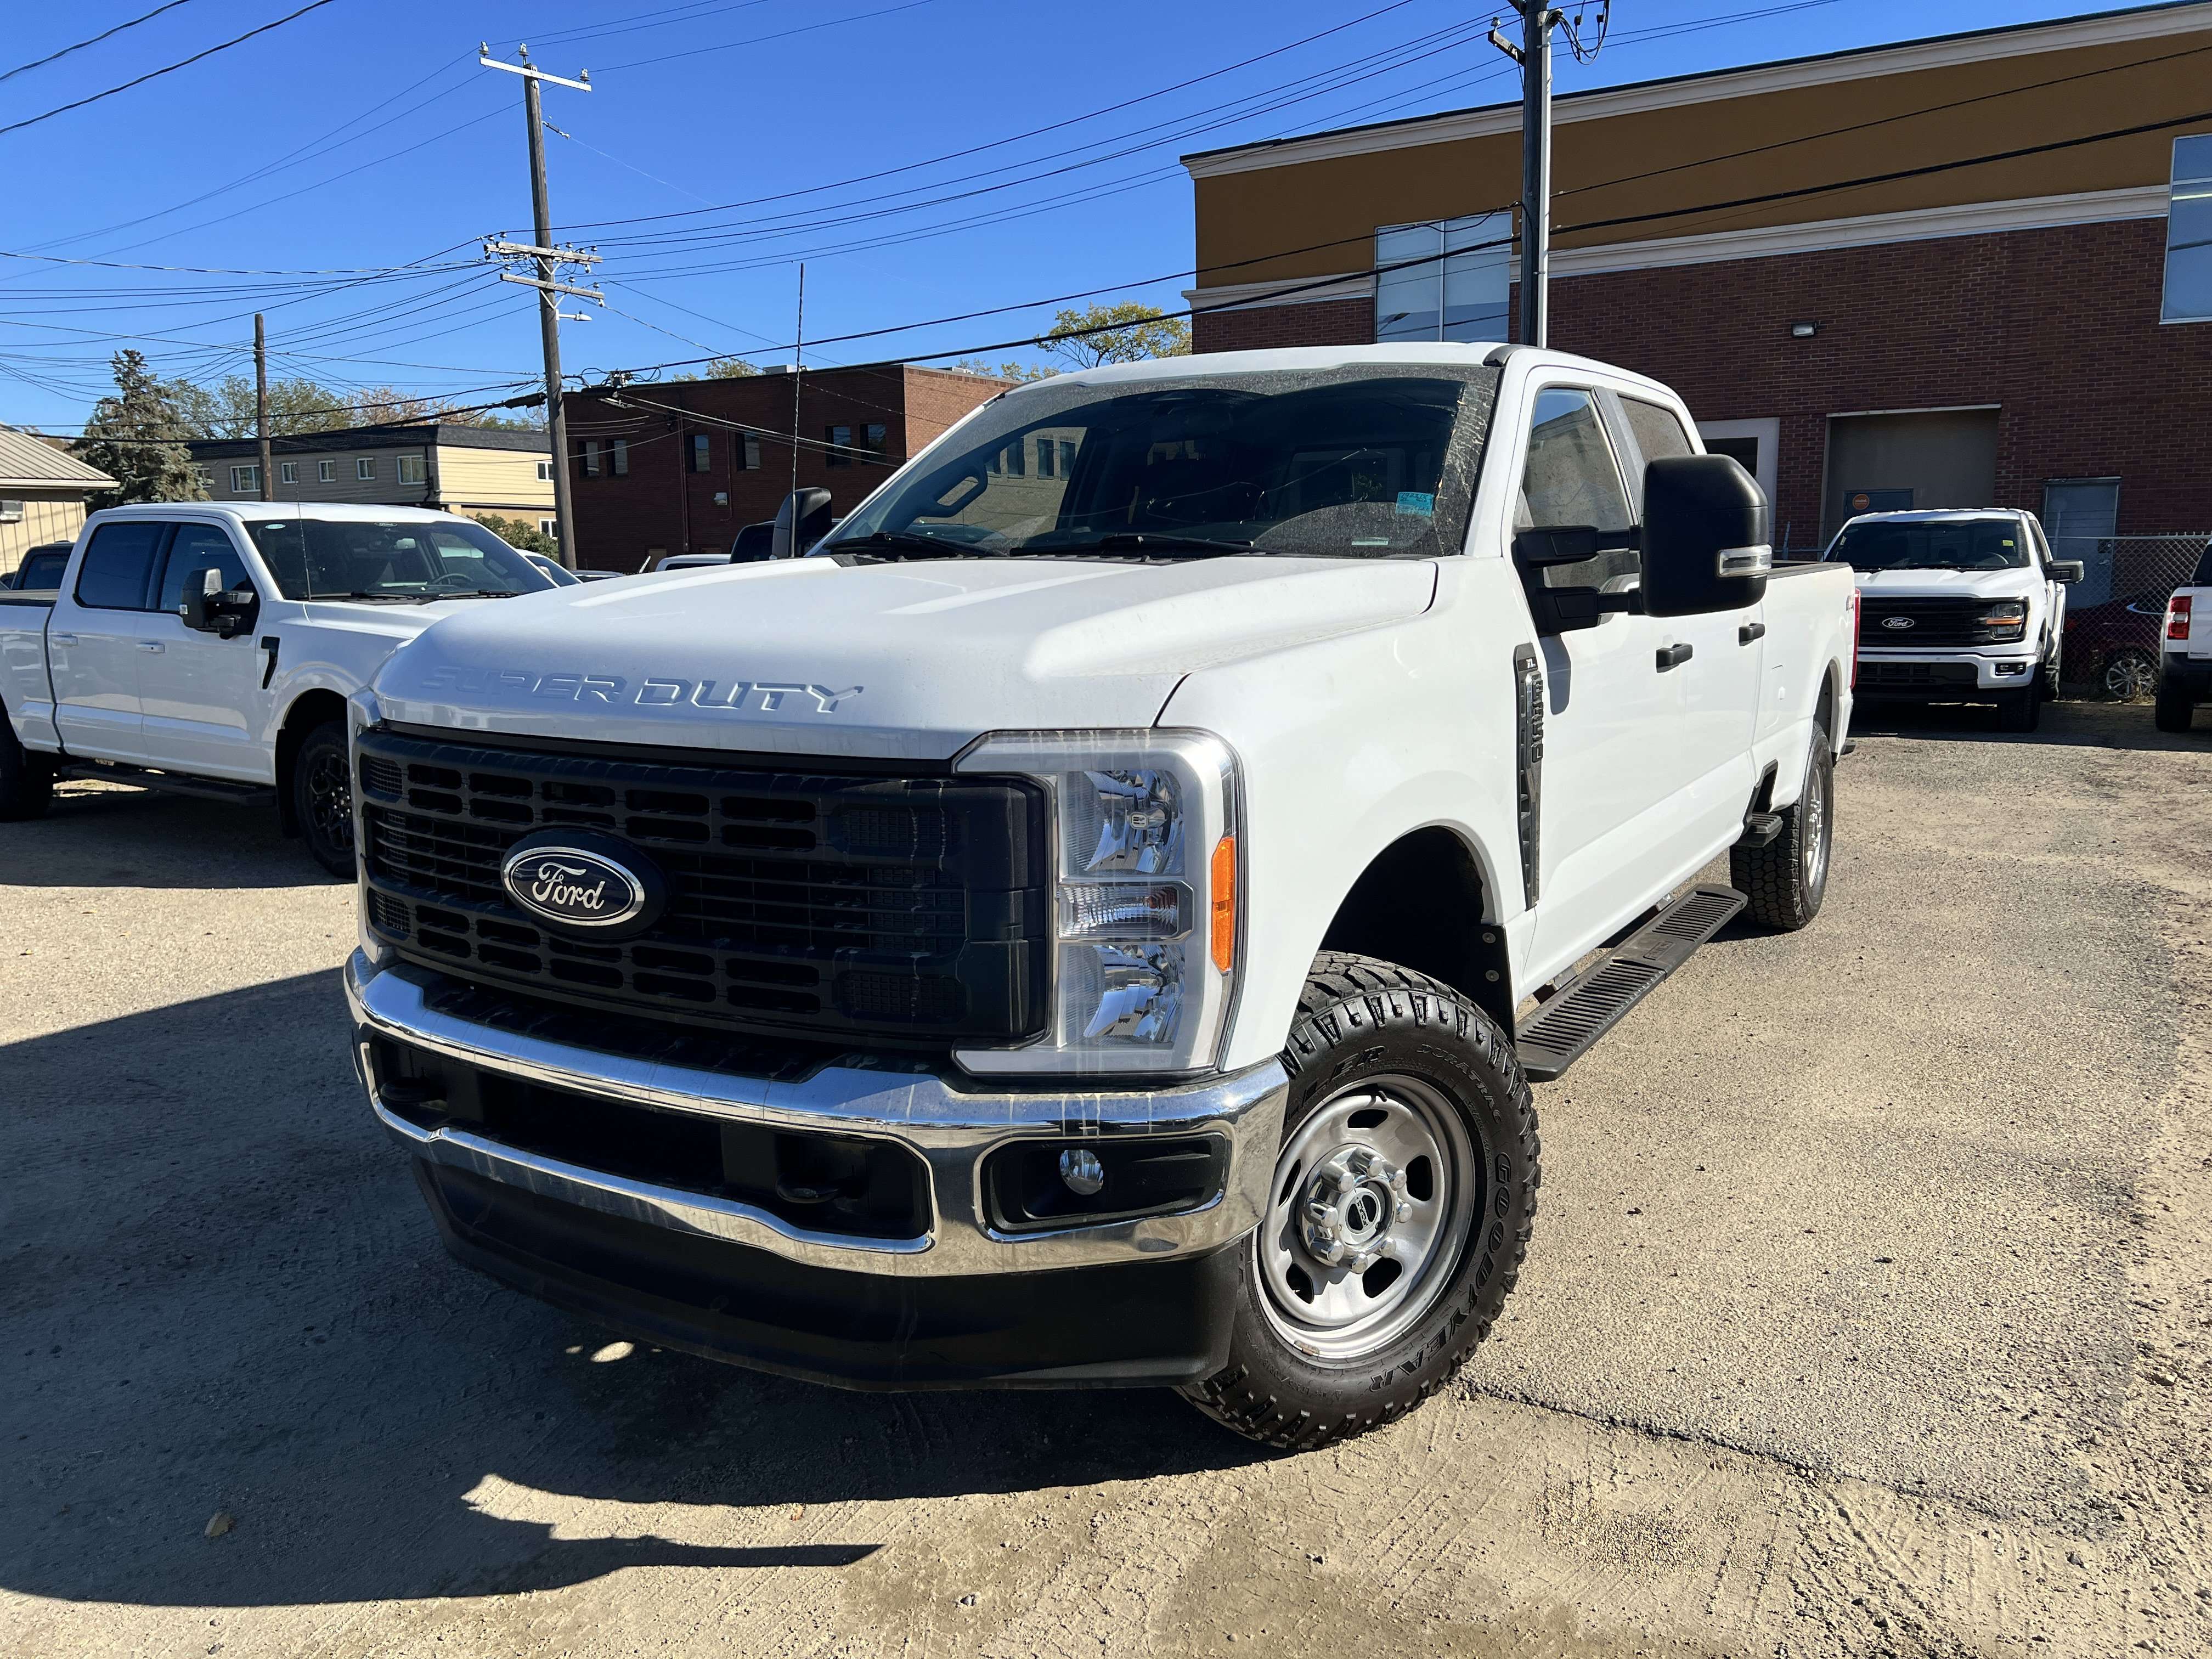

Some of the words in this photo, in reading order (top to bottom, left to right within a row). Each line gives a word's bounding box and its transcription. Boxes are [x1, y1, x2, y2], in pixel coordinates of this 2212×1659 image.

[1888, 618, 1908, 627] Ford
[421, 665, 627, 704] SUPER
[634, 676, 864, 713] DUTY
[531, 861, 606, 911] Ford
[1414, 1043, 1503, 1125] DURATRAC
[1369, 1152, 1512, 1394] GOODYEAR
